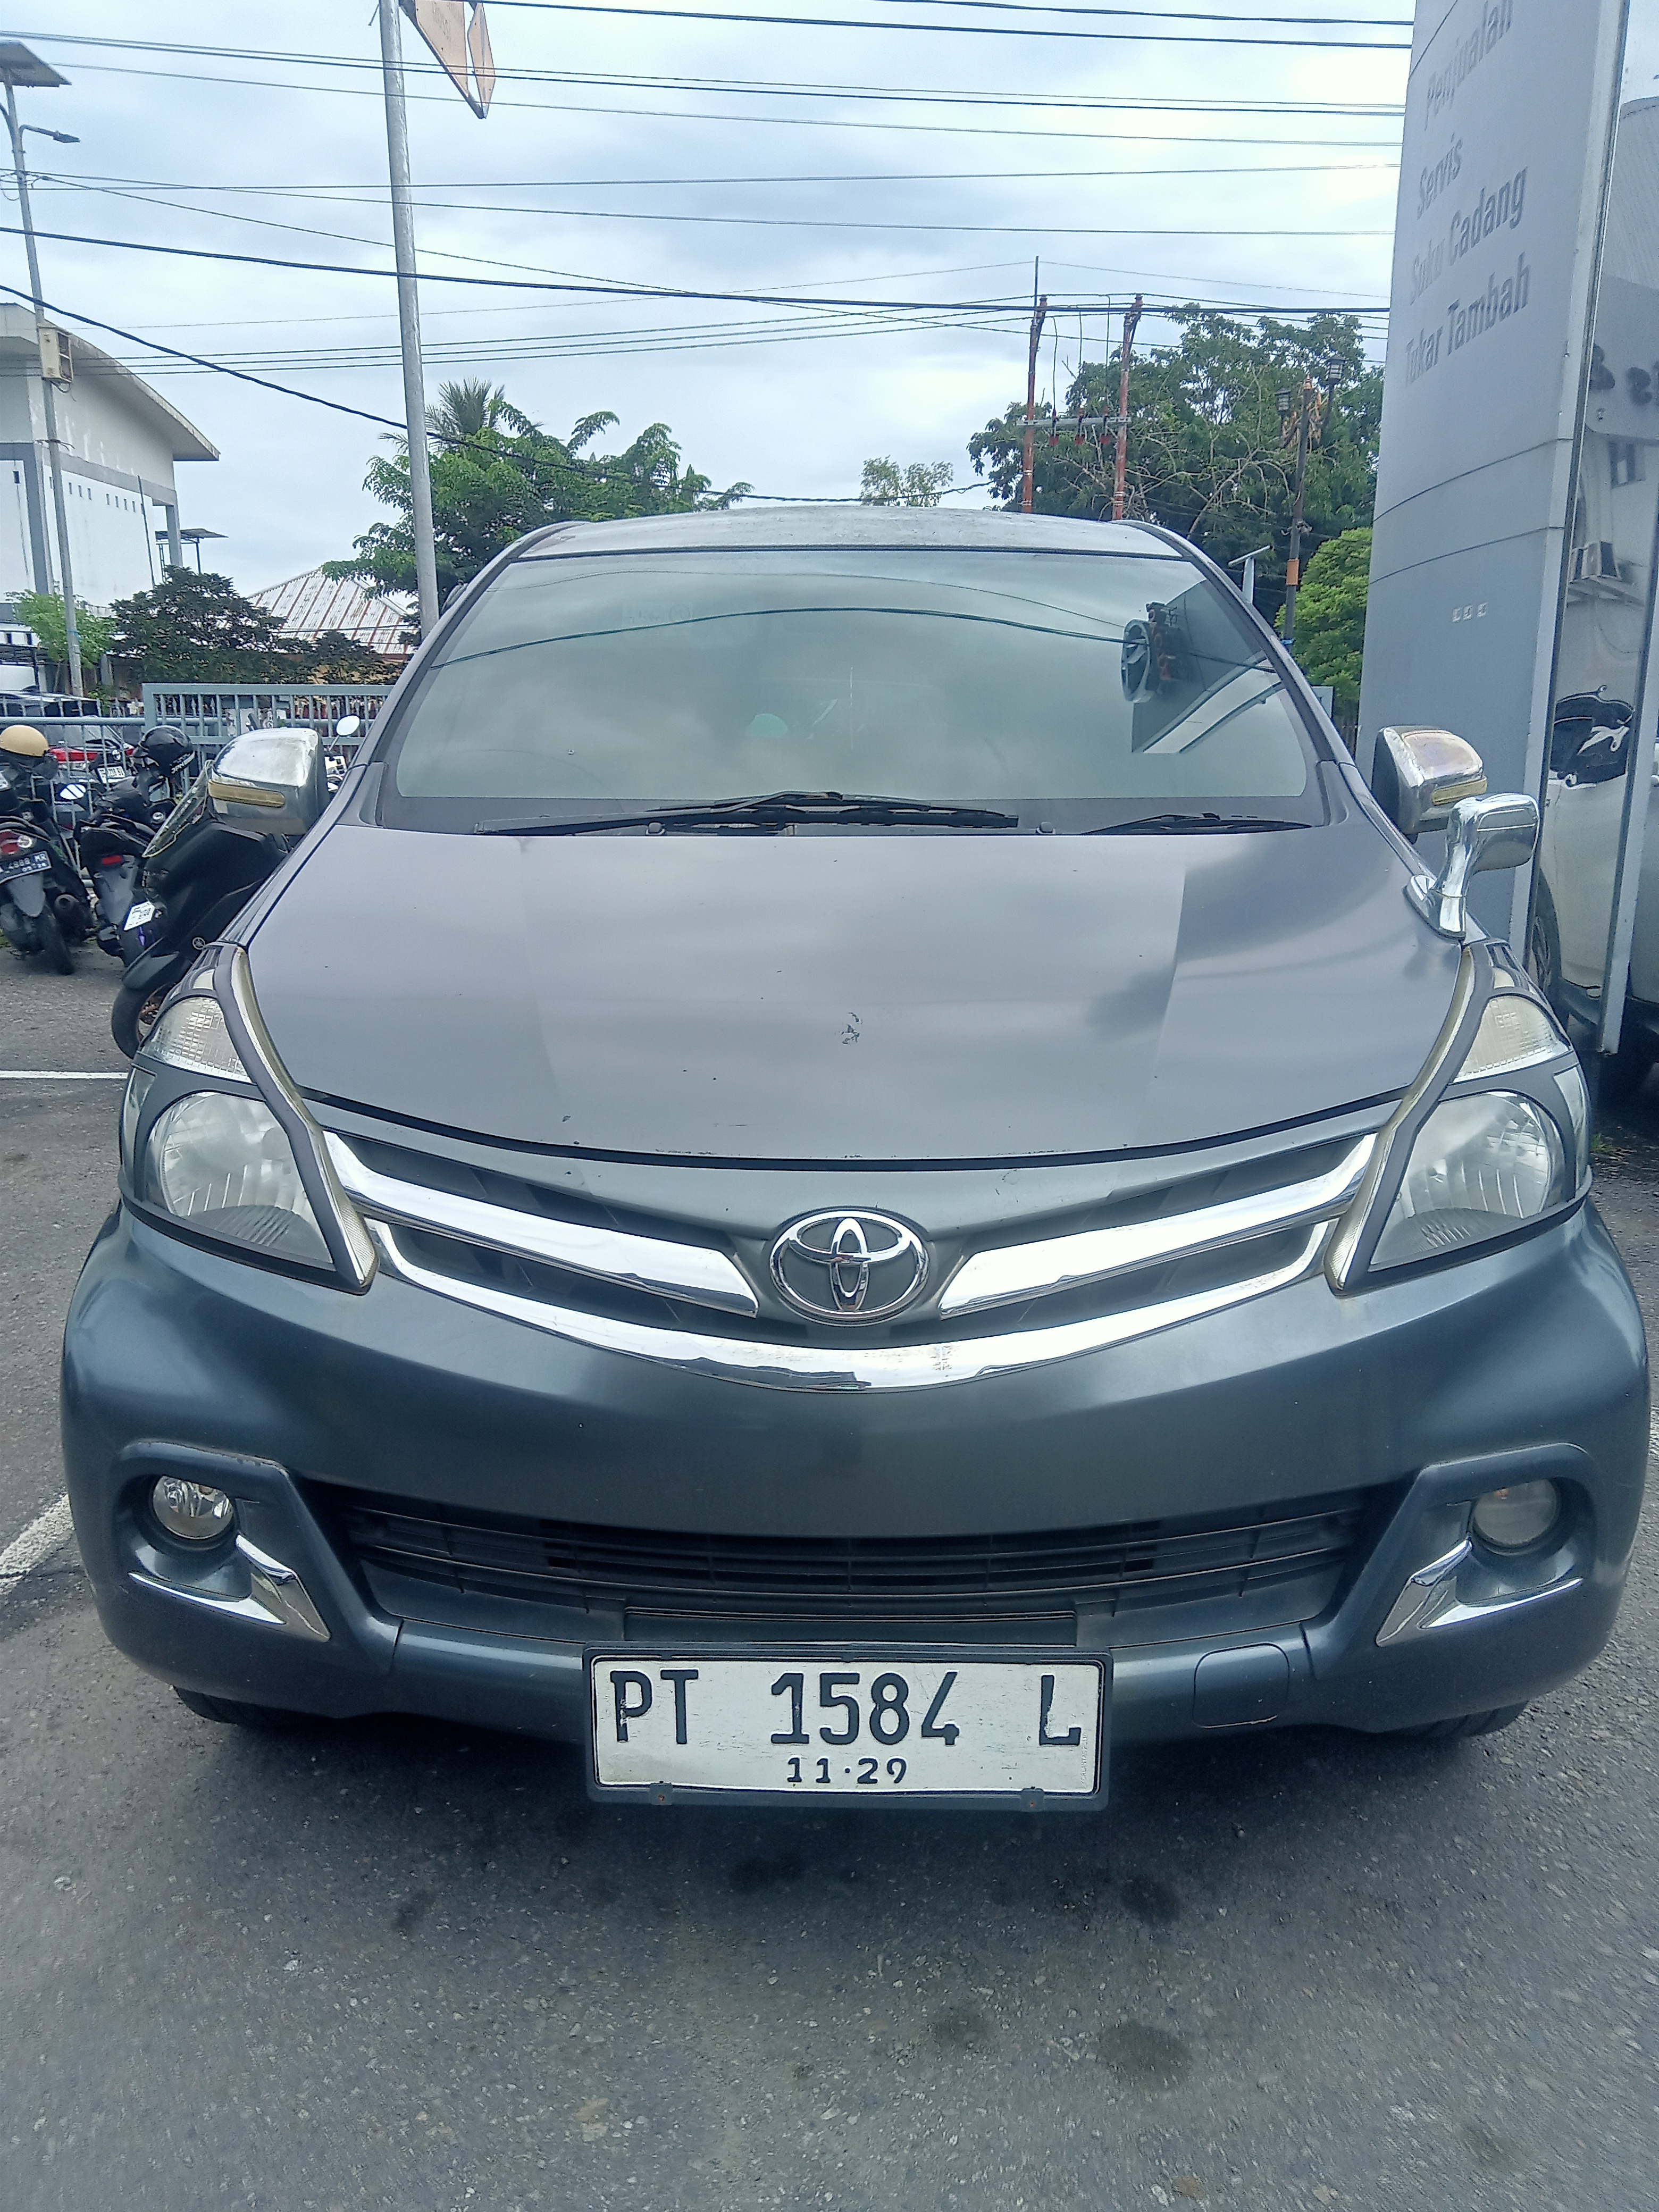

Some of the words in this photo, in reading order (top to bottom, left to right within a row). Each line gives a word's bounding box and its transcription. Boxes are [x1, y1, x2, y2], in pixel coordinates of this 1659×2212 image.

[1425, 0, 1513, 131] Penjualan
[1410, 238, 1445, 306] Suku
[1448, 165, 1528, 266] Cadang
[1417, 132, 1462, 220] Servis
[1405, 325, 1444, 389] Tukar
[1447, 251, 1531, 357] Tambah
[610, 1669, 699, 1745] PT
[770, 1671, 960, 1746] 1584
[1039, 1674, 1082, 1746] L
